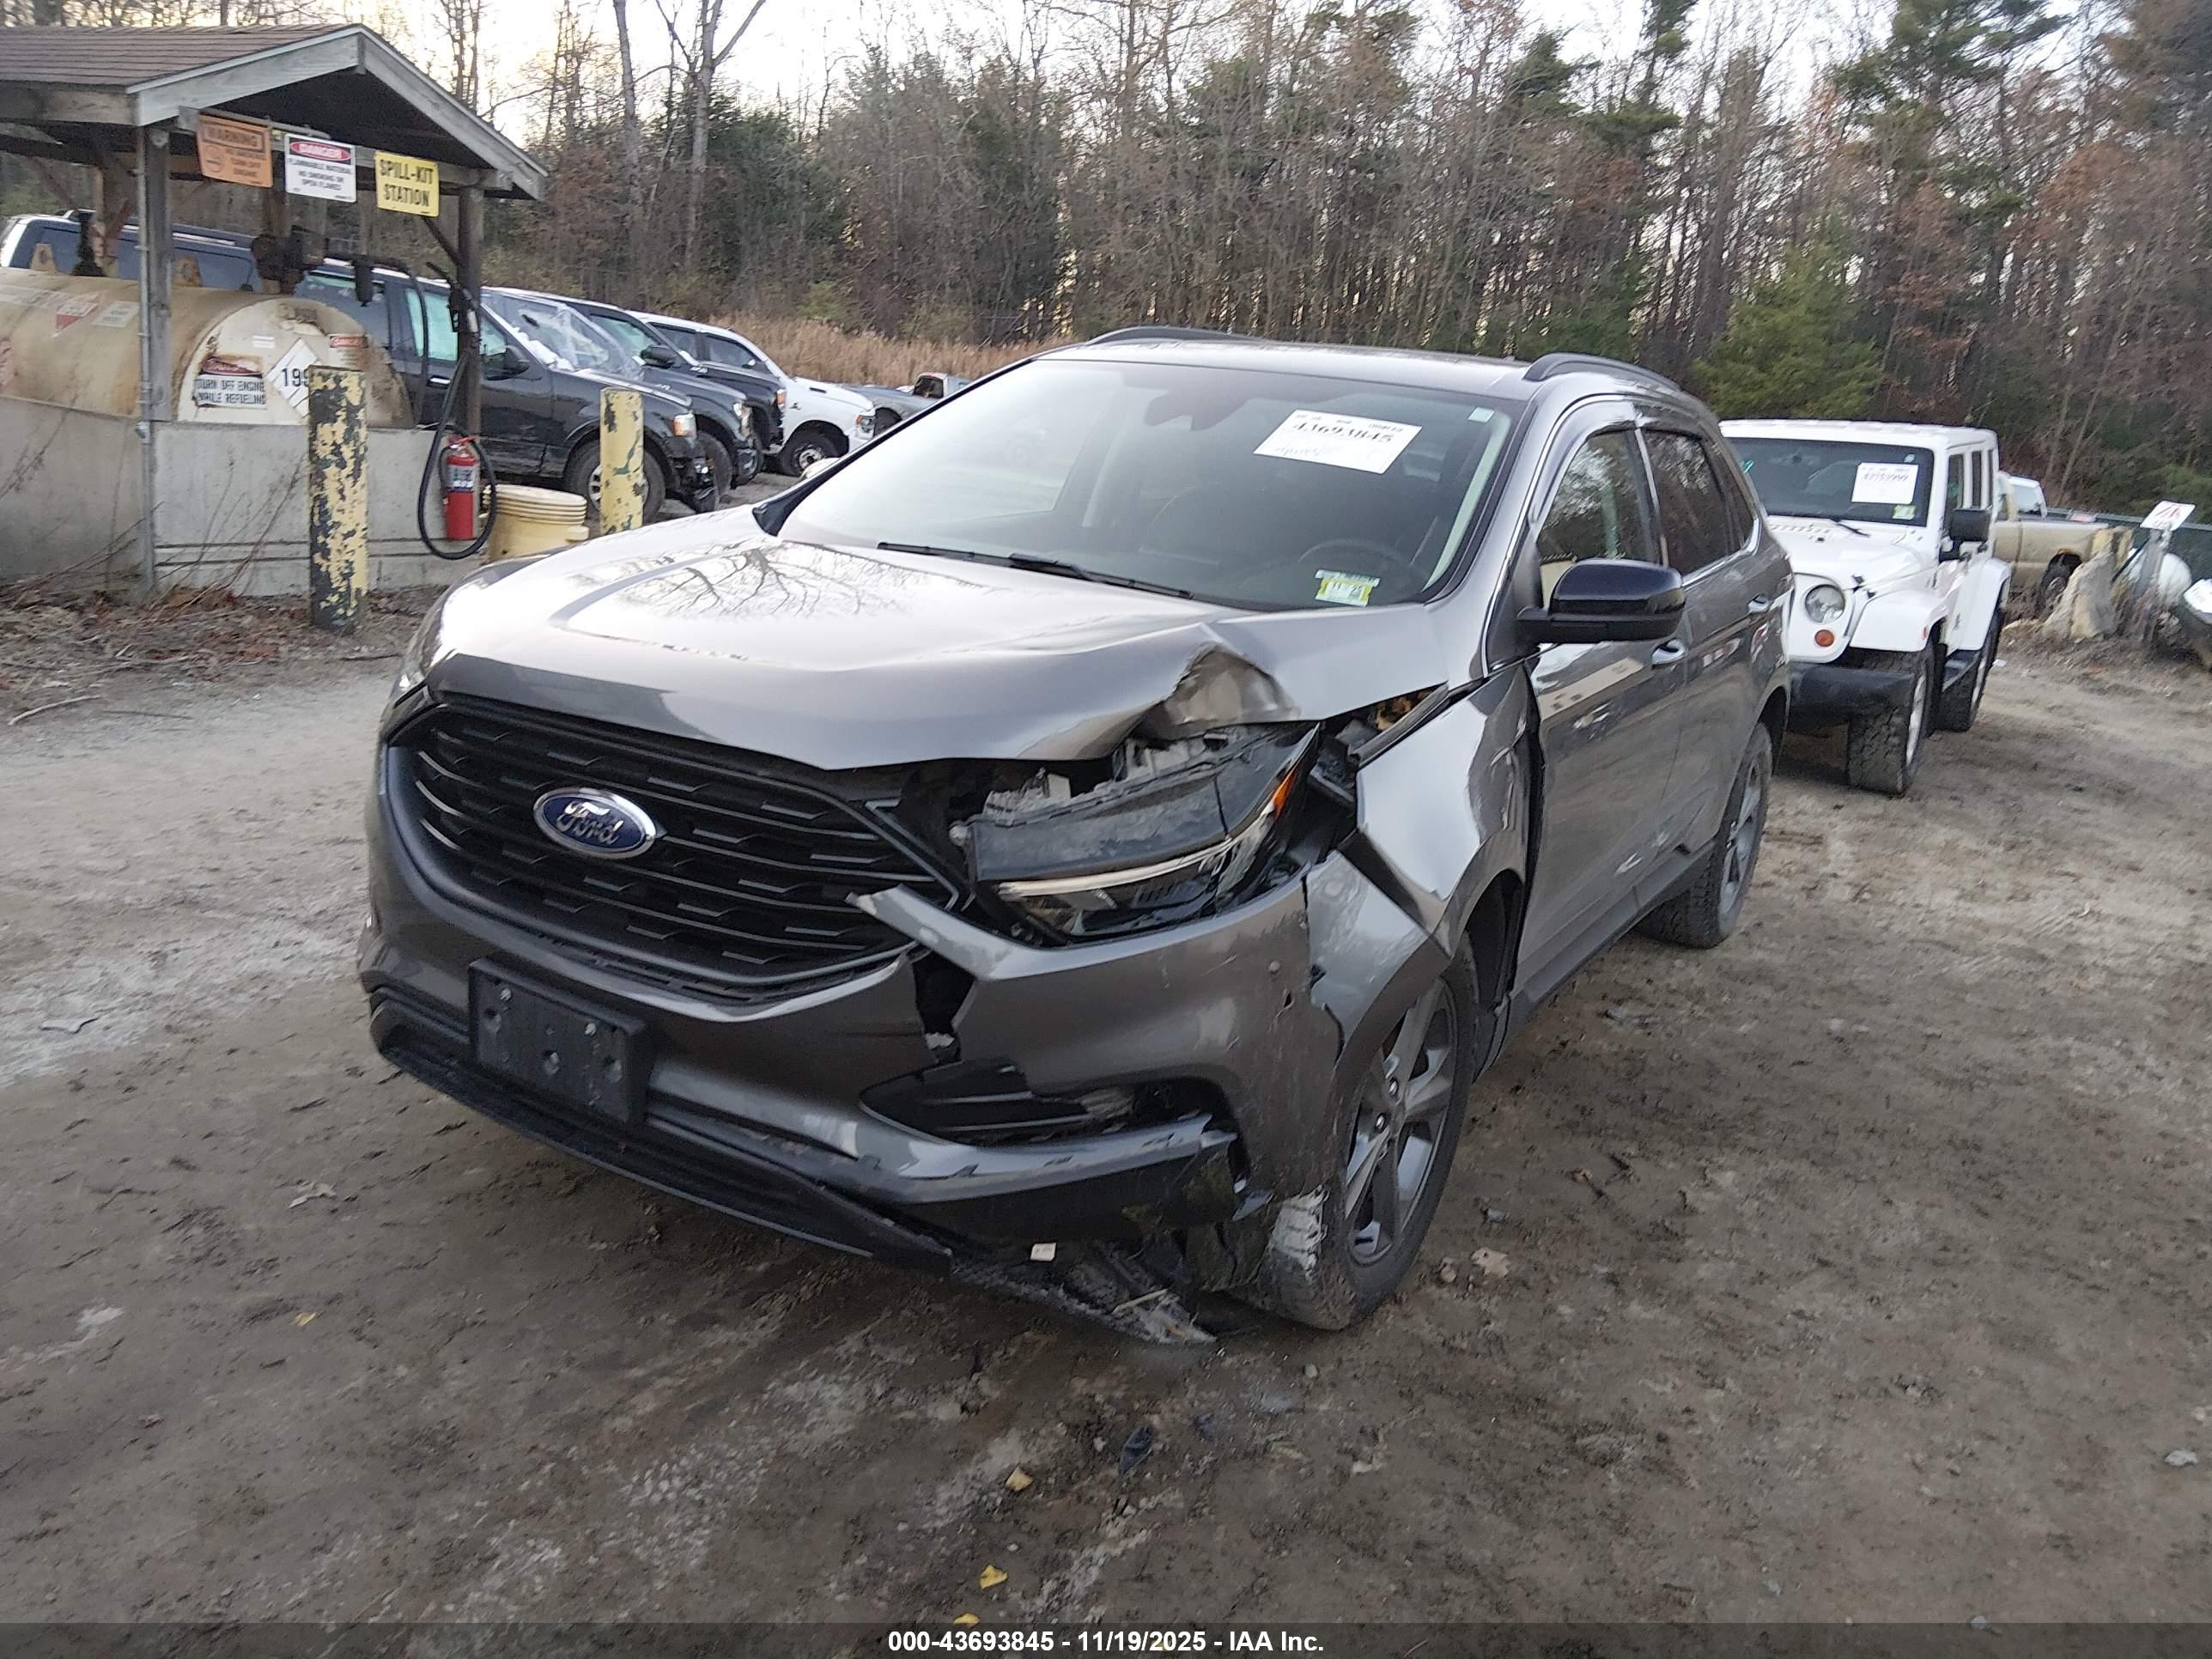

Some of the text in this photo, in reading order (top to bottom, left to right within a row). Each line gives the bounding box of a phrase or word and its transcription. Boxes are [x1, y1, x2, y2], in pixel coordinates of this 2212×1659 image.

[299, 143, 342, 160] DANGER
[380, 159, 434, 185] SPILL-KIT
[384, 183, 430, 207] STATION
[222, 380, 235, 390] OFF
[556, 800, 624, 846] Ford
